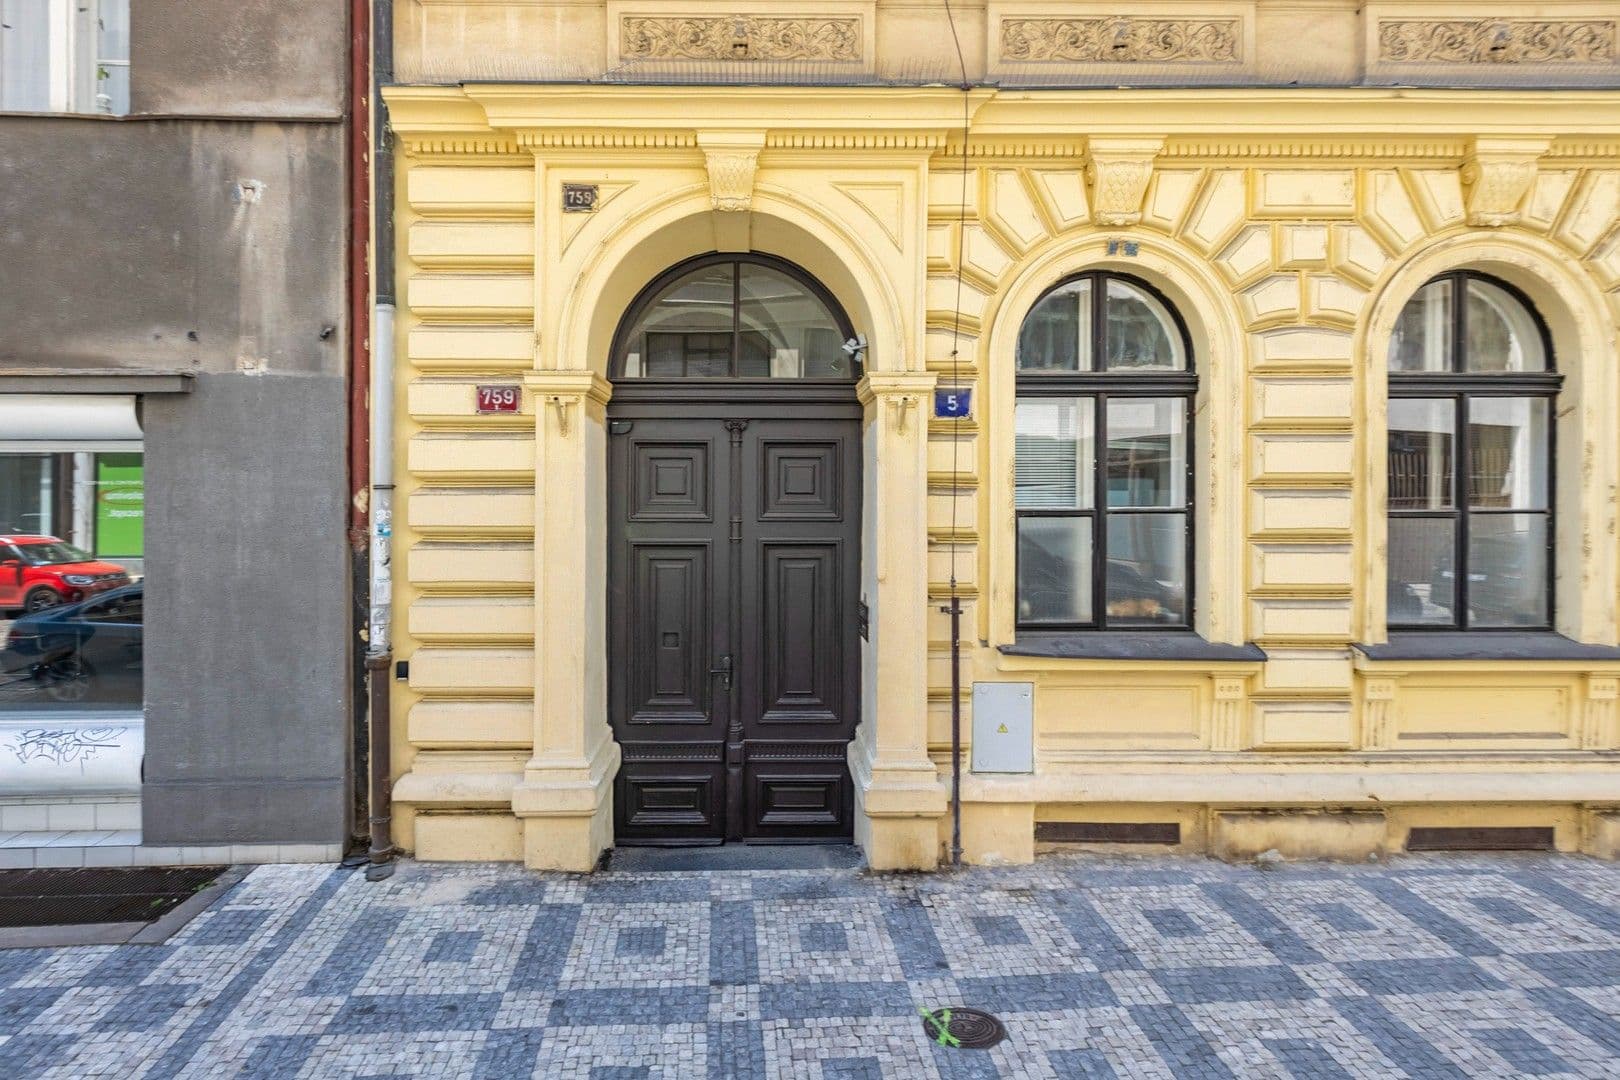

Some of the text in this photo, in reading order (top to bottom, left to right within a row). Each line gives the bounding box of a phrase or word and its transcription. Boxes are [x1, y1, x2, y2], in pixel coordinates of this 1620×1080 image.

[567, 191, 592, 204] 759
[482, 389, 514, 405] 759
[947, 395, 959, 411] 5
